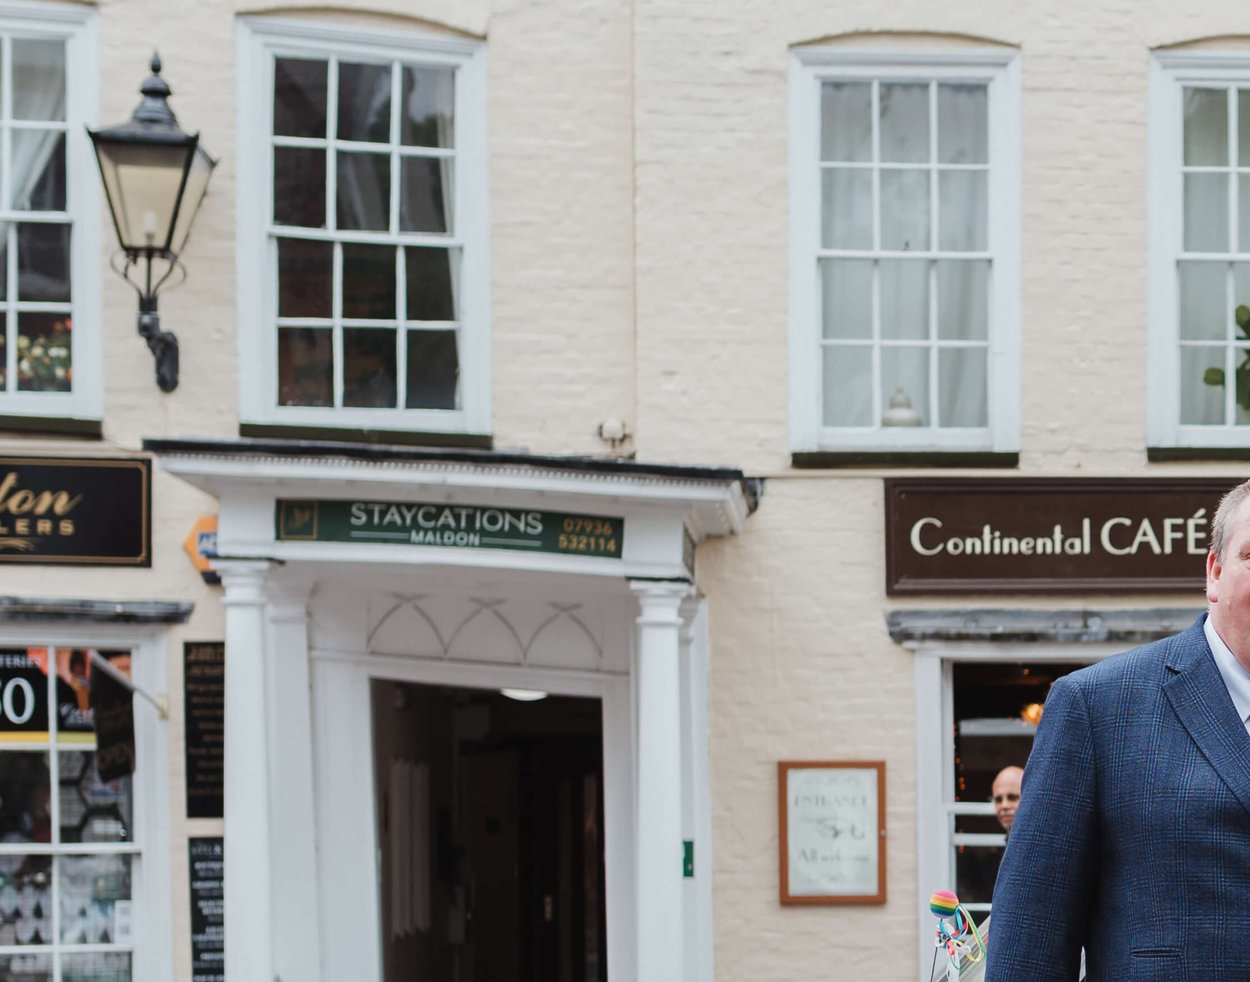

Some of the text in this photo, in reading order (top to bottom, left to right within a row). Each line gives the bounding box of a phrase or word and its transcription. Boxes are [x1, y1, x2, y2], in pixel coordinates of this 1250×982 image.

[350, 502, 544, 535] STAYCATIONS
[910, 508, 1208, 556] Continental CAFÉ
[410, 529, 481, 547] MALDON
